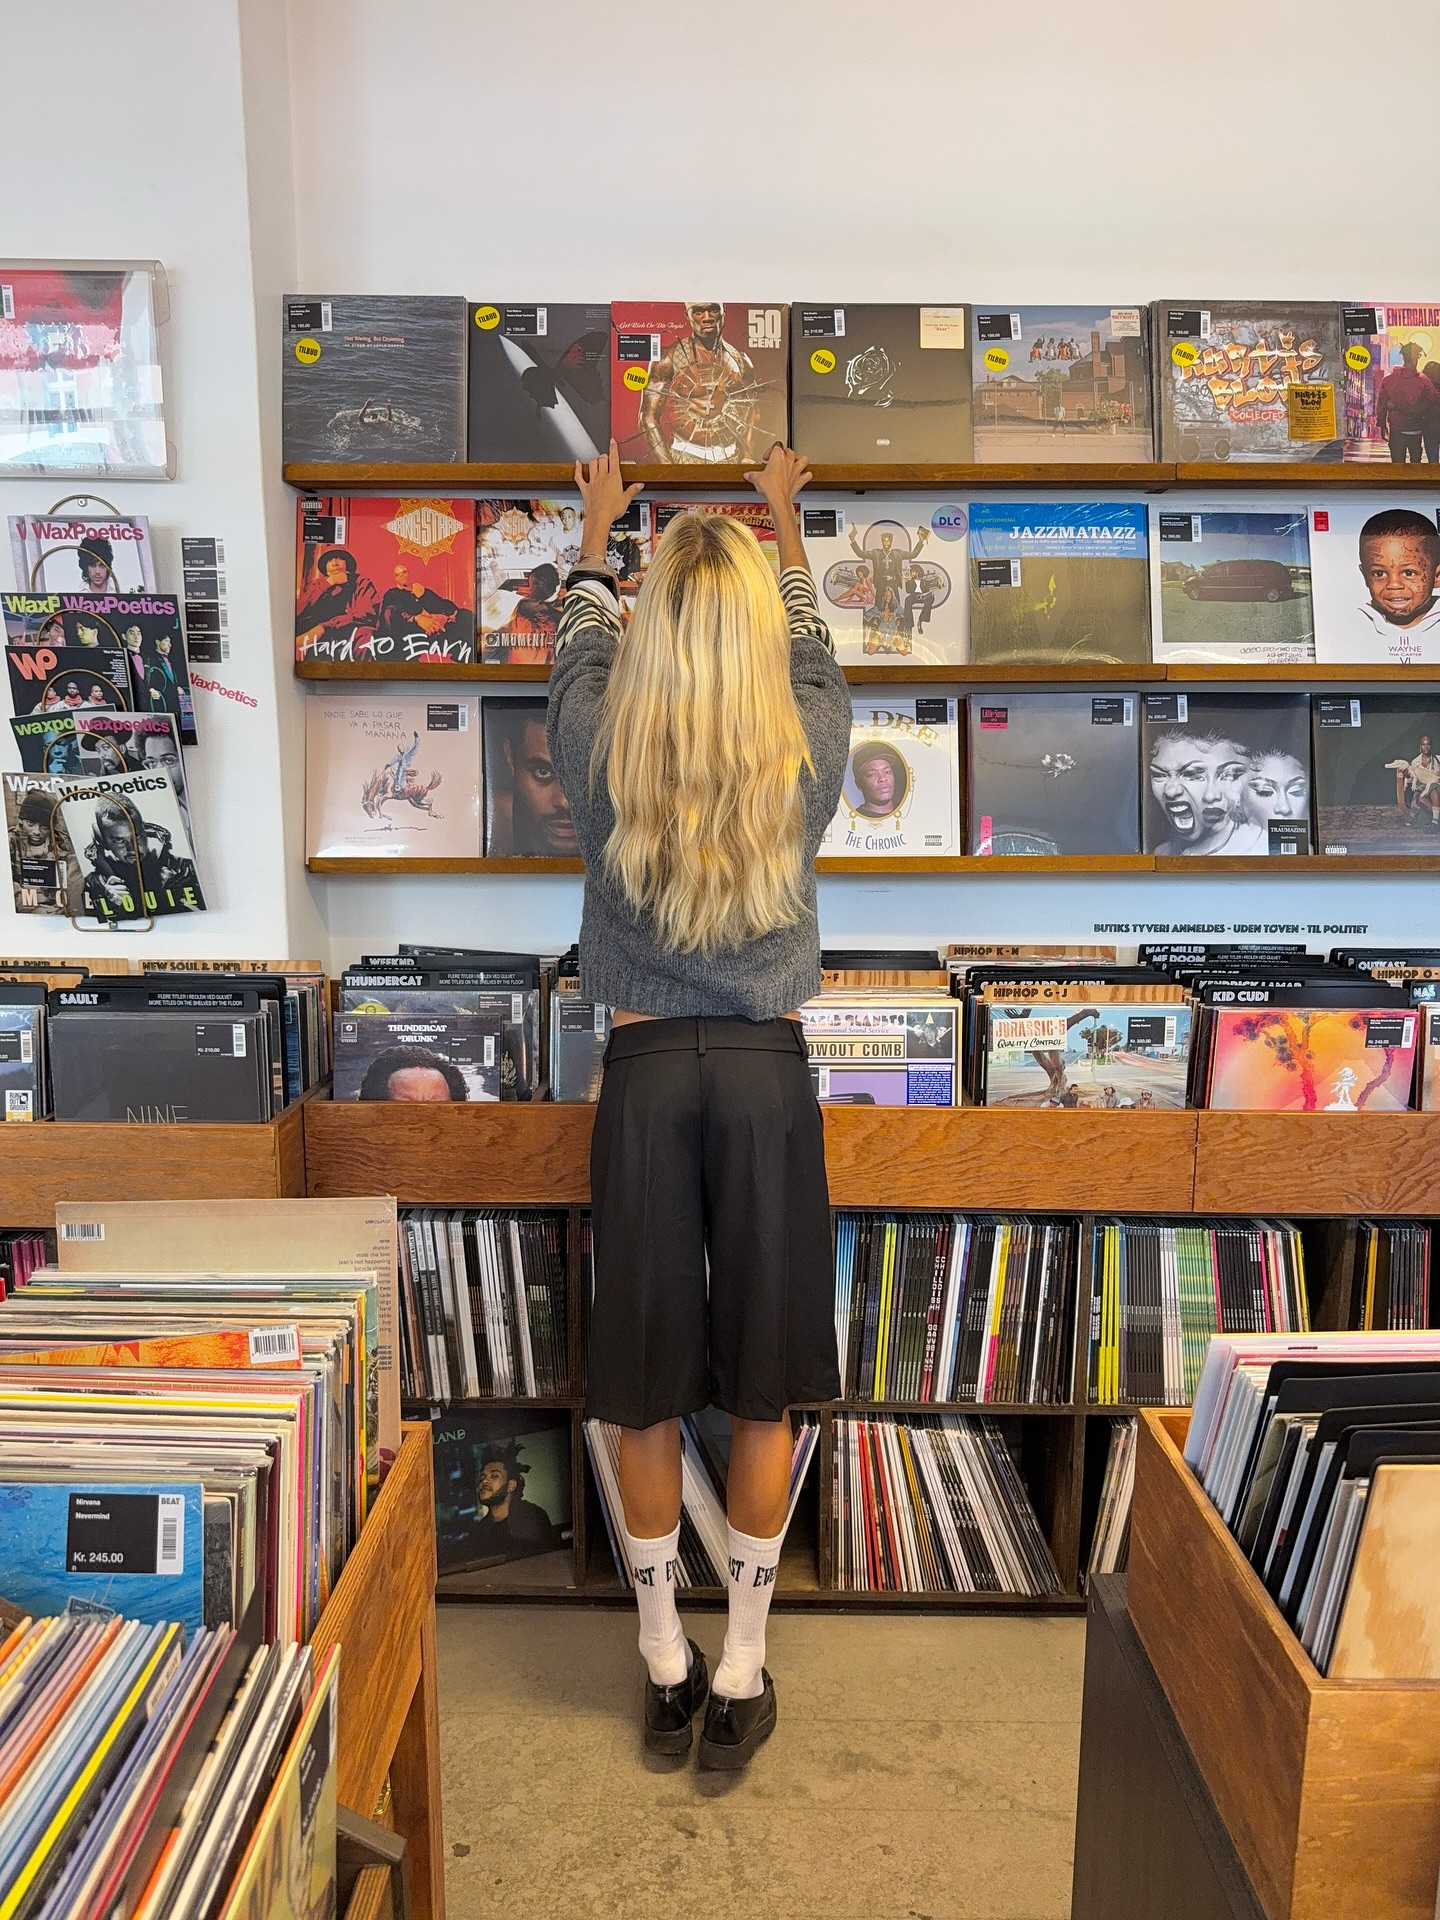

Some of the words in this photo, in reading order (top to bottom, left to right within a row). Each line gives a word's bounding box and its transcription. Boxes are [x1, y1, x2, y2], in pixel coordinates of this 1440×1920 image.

[478, 312, 498, 324] TILBUD
[748, 308, 782, 338] 50
[1386, 308, 1440, 327] ENTERGALAC
[616, 322, 630, 330] Get
[382, 336, 405, 344] Drowning
[748, 338, 782, 349] CENT
[298, 345, 318, 357] TILBUD
[1174, 348, 1195, 362] TILBUD
[813, 354, 833, 369] TILBUD
[987, 354, 1007, 366] TILBUD
[1348, 352, 1369, 364] TILBUD
[626, 372, 646, 385] TILBUD
[1232, 410, 1285, 421] COLLECTED
[938, 516, 961, 526] DLC
[974, 516, 1016, 524] experimental
[32, 522, 144, 542] WaxPoetics
[1009, 526, 1136, 540] JAZZMATAZZ
[62, 595, 176, 616] WaxPoetics
[299, 627, 358, 663] Hard
[367, 631, 395, 662] to
[402, 633, 472, 664] Earn
[501, 633, 546, 651] MOMENT
[1400, 636, 1409, 646] lil
[9, 648, 58, 681] WP
[324, 710, 346, 719] NADIE
[350, 710, 370, 718] SABE
[386, 711, 403, 720] QUE
[78, 718, 170, 734] waxpoetics
[372, 721, 401, 731] PASAR
[365, 728, 408, 740] MAÑANA
[58, 775, 168, 803] WaxPoetics
[1270, 826, 1307, 834] TRAUMAZINE
[844, 830, 864, 848] THE
[865, 834, 908, 850] CHRONIC
[1094, 923, 1130, 934] BUTIKS
[1132, 923, 1170, 934] TYVERI
[1171, 923, 1226, 934] ANMELDES
[1233, 924, 1262, 934] UDEN
[1263, 924, 1299, 934] TØVEN
[1306, 924, 1322, 934] TIL
[1323, 924, 1368, 935] POLITIET
[954, 946, 993, 956] HIPHOP
[996, 947, 1004, 956] K
[1011, 947, 1019, 956] N
[1146, 946, 1170, 954] MAC
[1170, 946, 1206, 954] MILLER
[1152, 954, 1168, 962] MF
[1169, 954, 1206, 962] DOOM
[142, 962, 168, 970] NEW
[170, 962, 200, 971] SOUL
[202, 962, 210, 971] &
[250, 962, 268, 972] T-Z
[1358, 961, 1406, 970] OUTKAST
[833, 973, 840, 982] F
[1377, 969, 1419, 979] HIPHOP
[1423, 970, 1432, 979] O
[344, 976, 422, 987] THUNDERCAT
[994, 988, 1039, 998] HIPHOP
[1044, 988, 1053, 998] G
[1062, 988, 1068, 998] J
[1212, 991, 1236, 1002] KID
[1238, 991, 1269, 1002] CUDI
[1413, 985, 1436, 998] NAS
[60, 993, 98, 1005] SAULT
[388, 1024, 448, 1032] THUNDERCAT
[996, 1019, 1066, 1038] JURASSIC-5
[998, 1038, 1028, 1049] QUALITY
[1030, 1038, 1066, 1048] CONTROL
[862, 1044, 902, 1057] COMB
[338, 1258, 353, 1266] jean's
[929, 1256, 940, 1311] CHILDISH
[936, 1256, 946, 1311] CHILDISH
[432, 1428, 466, 1445] LAND
[76, 1498, 101, 1506] Nirvana
[75, 1512, 110, 1520] Nevermind
[73, 1552, 87, 1562] Kr.
[89, 1552, 124, 1563] 245.00
